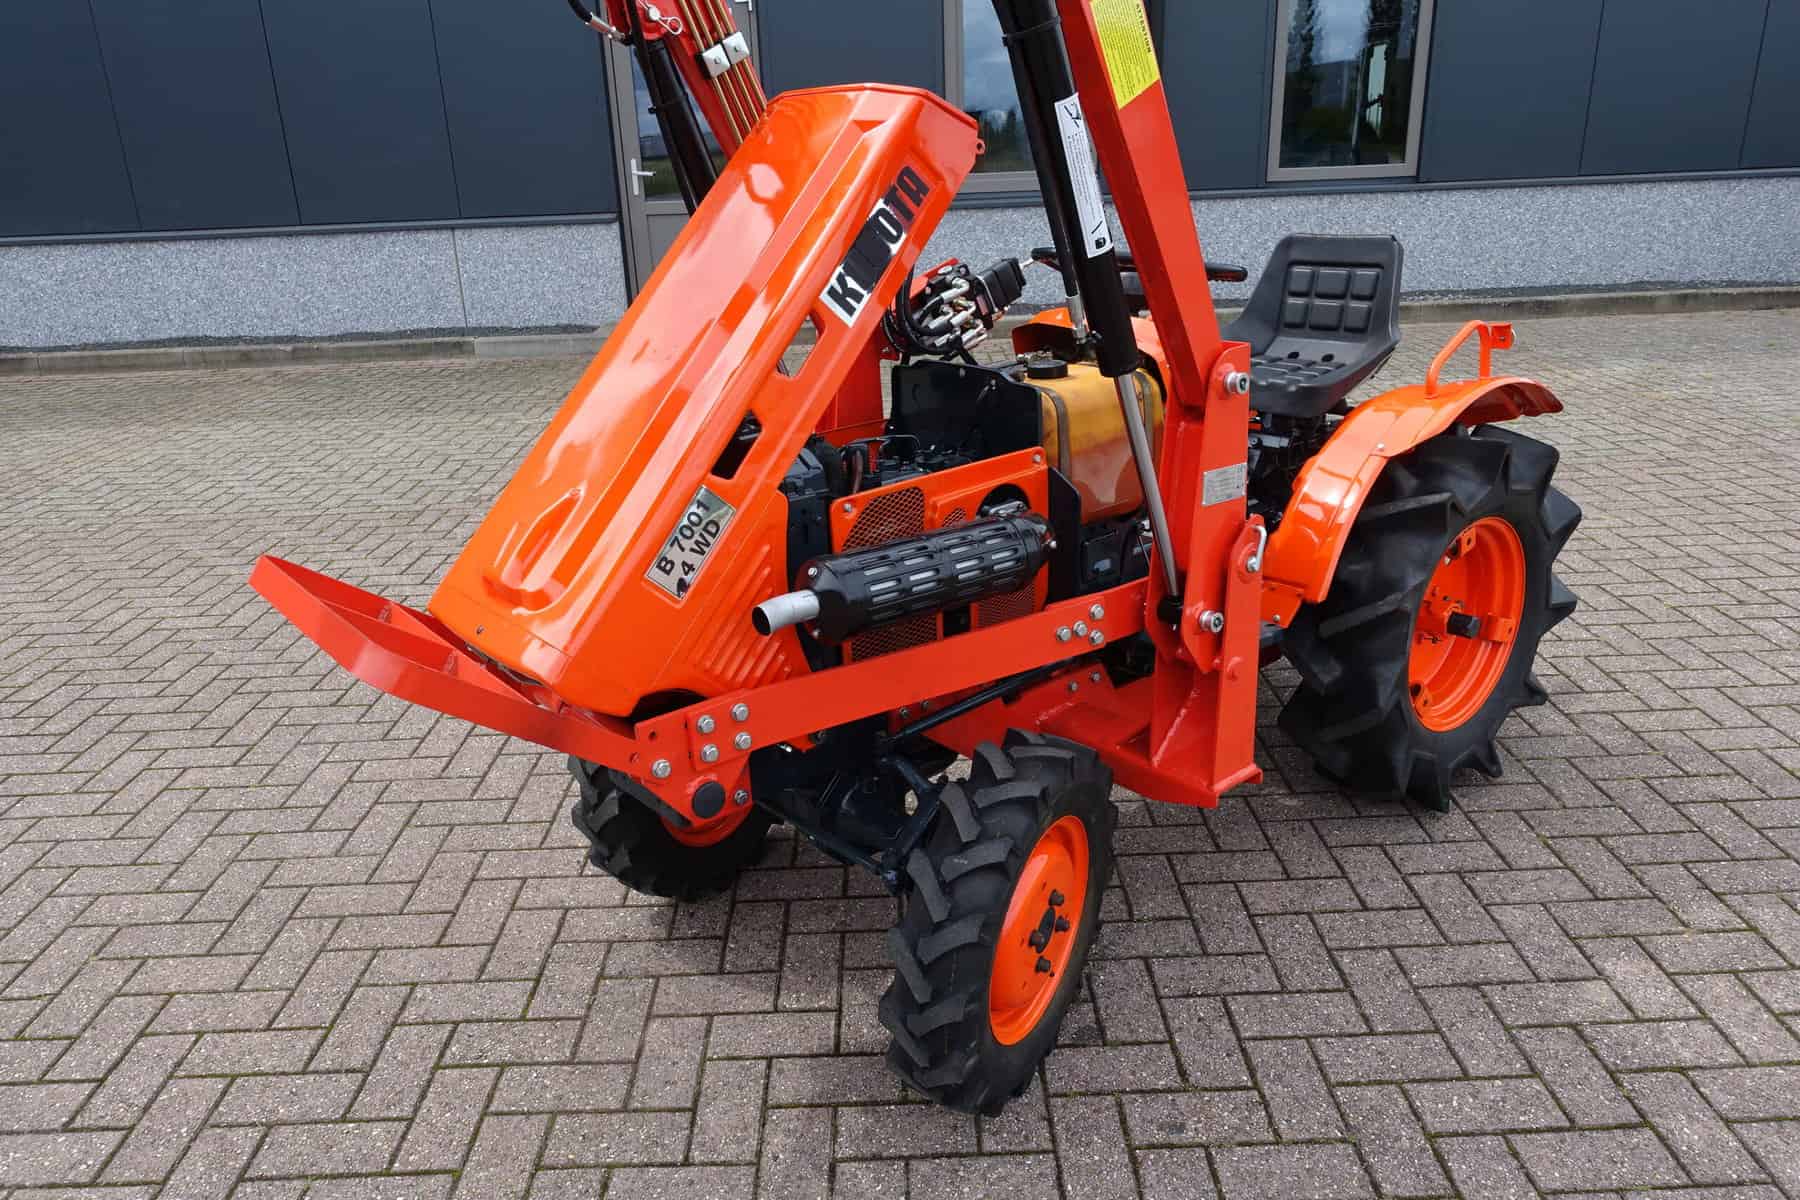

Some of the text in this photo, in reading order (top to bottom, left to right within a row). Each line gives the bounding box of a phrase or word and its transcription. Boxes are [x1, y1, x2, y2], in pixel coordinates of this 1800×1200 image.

[827, 165, 930, 317] KOTA
[656, 499, 710, 576] B 7001
